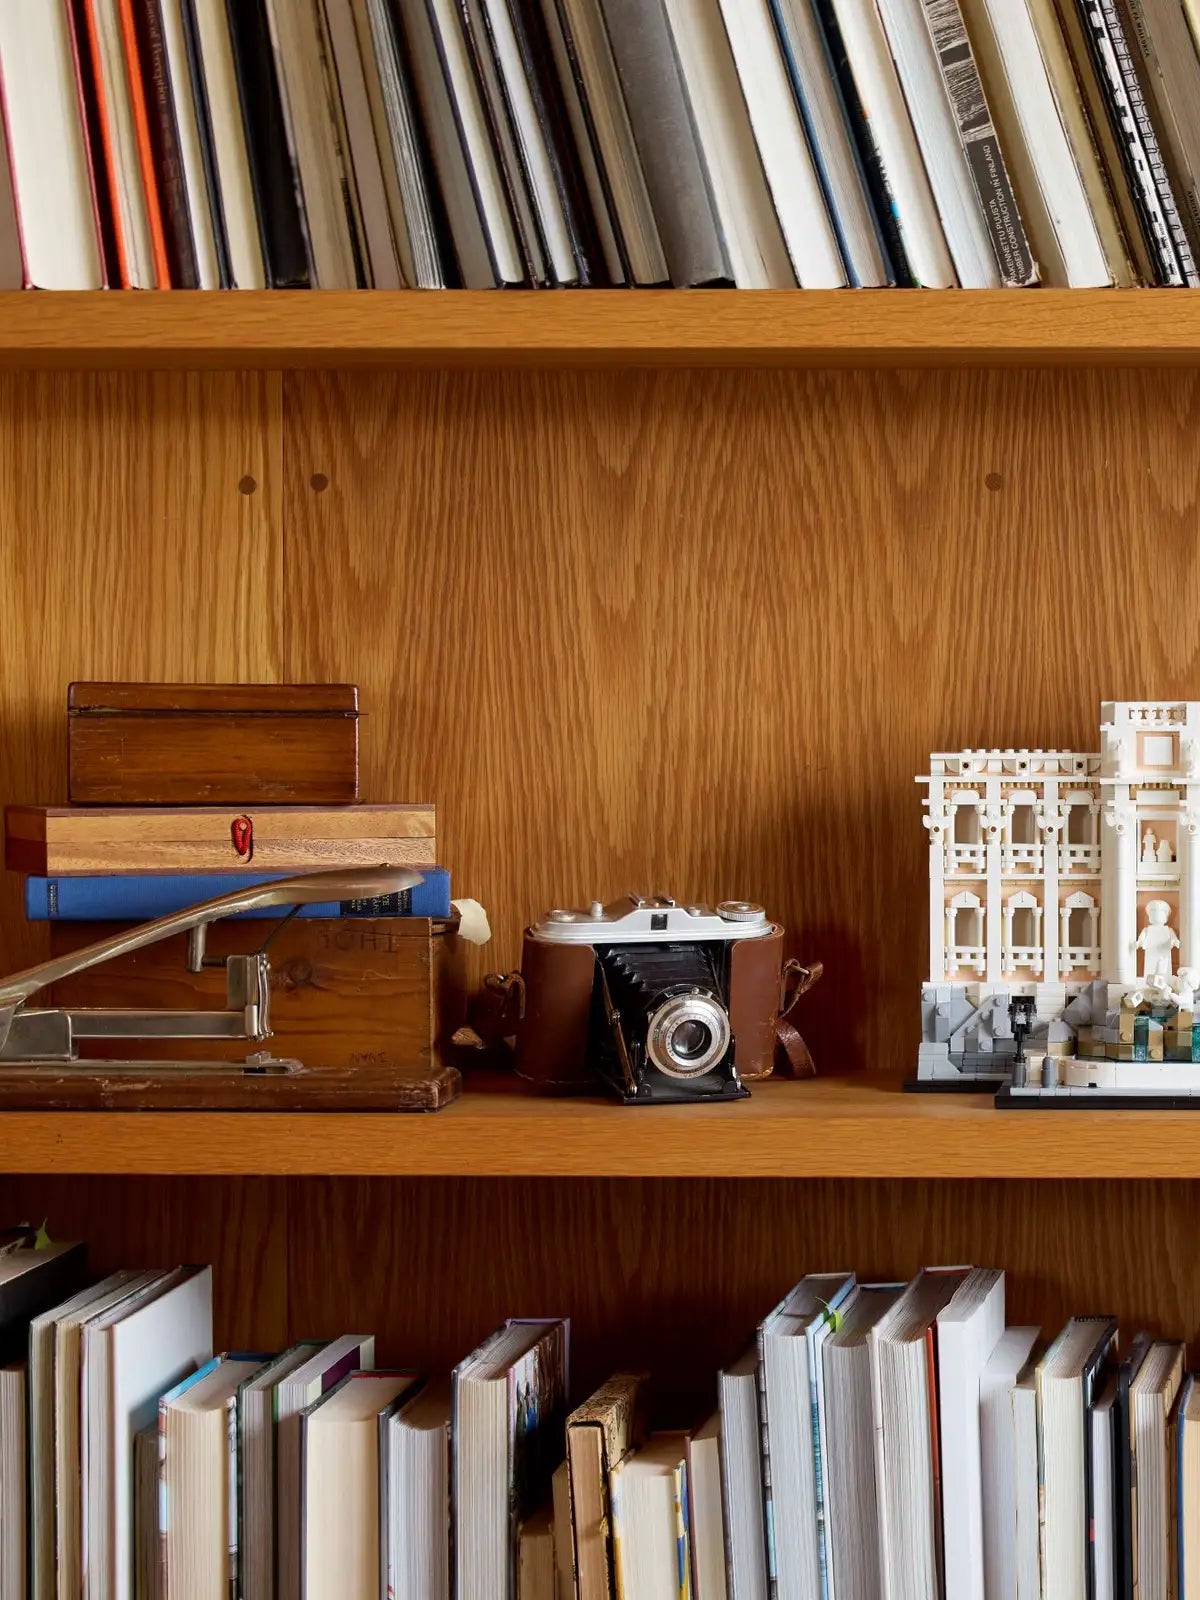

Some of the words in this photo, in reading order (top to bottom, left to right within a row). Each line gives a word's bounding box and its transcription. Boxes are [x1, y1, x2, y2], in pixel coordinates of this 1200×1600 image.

[1137, 22, 1150, 58] MALLORCA
[152, 43, 168, 105] Perception
[983, 145, 997, 178] FINLAND
[993, 179, 1000, 188] IN
[990, 199, 1004, 230] PUUSTA
[997, 188, 1018, 249] CONSTRUCTION
[997, 231, 1016, 281] RAKENNETTU
[1014, 250, 1026, 279] TIMBER
